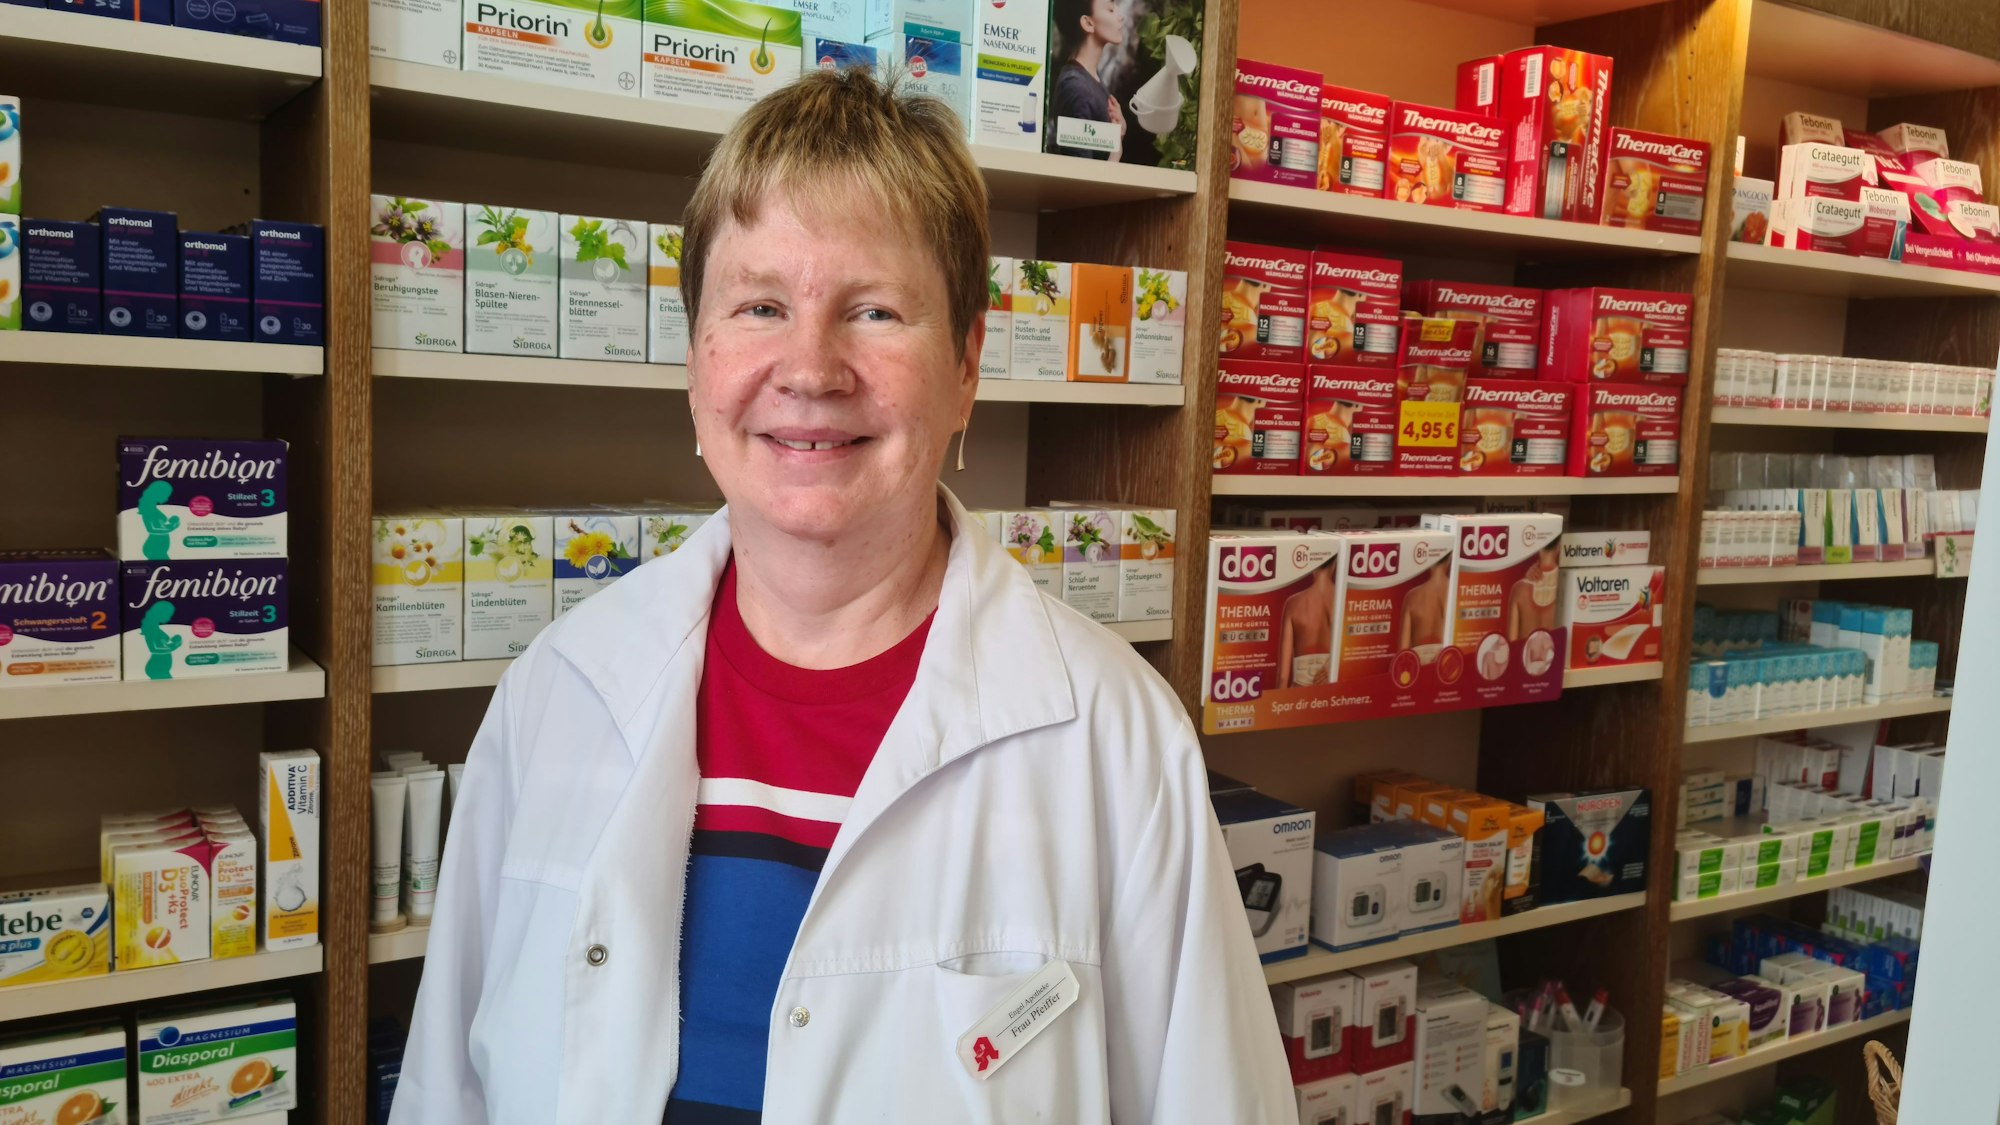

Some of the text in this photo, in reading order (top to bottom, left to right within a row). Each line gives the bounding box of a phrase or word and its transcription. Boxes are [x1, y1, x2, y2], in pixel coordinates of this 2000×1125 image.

[477, 3, 569, 37] Priorin
[478, 26, 519, 40] KAPSELN
[984, 22, 1019, 41] EMSER
[654, 34, 735, 64] Priorin
[984, 38, 1037, 55] NASENDUSCHE
[654, 56, 691, 68] KAPSELN
[1234, 69, 1320, 97] hermaCare
[1321, 98, 1386, 118] ermaCare
[1404, 110, 1503, 140] ThermaCare
[1800, 115, 1833, 131] Tebonin
[1586, 69, 1609, 208] ThermaCare
[1907, 126, 1938, 140] Tebonin
[1273, 140, 1279, 150] 8
[1616, 134, 1703, 160] ThermaCare
[1812, 148, 1860, 166] Crataegutt
[1344, 160, 1349, 169] 8
[1941, 161, 1972, 176] Tebonin
[1457, 177, 1463, 186] 8
[1659, 193, 1664, 202] 8
[1864, 190, 1899, 205] Tebonin
[1816, 202, 1861, 219] Crataegutt
[1960, 204, 1990, 218] Tebonin
[108, 217, 153, 228] orthomol
[28, 228, 74, 239] orthomol
[260, 230, 301, 240] orthomol
[184, 241, 227, 252] orthomol
[1316, 262, 1399, 283] ThermaCare
[374, 283, 439, 296] Beruhigungstee
[475, 289, 540, 301] Blasen-Nieren-
[475, 300, 508, 310] Spültee
[570, 298, 624, 309] Brennnessel-
[1438, 288, 1536, 309] ThermaCare
[1599, 295, 1688, 314] ThermaCare
[78, 309, 88, 317] 10
[570, 308, 598, 317] blätter
[1260, 304, 1279, 312] NACKEN
[228, 318, 238, 326] 10
[1260, 319, 1268, 328] 12
[1015, 333, 1052, 342] Bronchialtee
[1136, 333, 1173, 342] Johanniskraut
[1356, 327, 1364, 336] 12
[1547, 306, 1558, 366] ThermaCare
[1408, 346, 1472, 358] ThermaCare
[1487, 348, 1494, 356] 16
[1313, 375, 1394, 392] ThermaCare
[1467, 386, 1565, 404] ThermaCare
[1595, 390, 1677, 406] ThermaCare
[1403, 421, 1455, 441] 4,95 €
[1254, 434, 1264, 443] 12
[1353, 437, 1361, 446] 12
[1516, 445, 1524, 453] 16
[1400, 453, 1454, 463] ThermaCare
[126, 445, 276, 488] femibion
[228, 493, 257, 501] Stillzeit
[260, 489, 275, 508] 3
[1463, 526, 1508, 556] doc
[1296, 550, 1309, 563] 8h
[1564, 544, 1603, 558] Voltaren
[1222, 546, 1274, 579] doc
[1352, 543, 1398, 574] doc
[1126, 572, 1162, 581] Spitzwegerich
[0, 572, 107, 608] mibion
[129, 566, 278, 609] femibion
[1460, 584, 1502, 596] THERMA
[1577, 577, 1629, 593] Voltaren
[376, 602, 445, 612] Kamillenblüten
[472, 598, 527, 608] Lindenblüten
[1348, 599, 1393, 612] THERMA
[229, 610, 259, 618] Stillzeit
[262, 606, 277, 623] 3
[1220, 605, 1271, 618] THERMA
[1461, 608, 1499, 618] NACKEN
[14, 616, 88, 627] Schwangerschaft
[91, 611, 107, 630] 2
[1348, 624, 1389, 634] RÜCKEN
[1221, 632, 1267, 641] RÜCKEN
[1214, 671, 1260, 700] doc
[1216, 705, 1255, 716] THERMA
[1272, 695, 1373, 714] Spar dir den Schmerz.
[288, 766, 296, 811] ADDITIVA
[297, 765, 308, 814] Vitamin C
[1273, 819, 1312, 834] OMRON
[1380, 853, 1402, 864] OMRON
[218, 864, 255, 874] Protect
[158, 869, 178, 915] D3 +K2
[180, 867, 189, 929] DuoProtect
[8, 940, 32, 952] plus
[1008, 982, 1050, 1019] Engel Apotheke
[1011, 992, 1061, 1038] Frau Pfeiffer
[184, 1027, 250, 1043] MAGNESIUM
[152, 1043, 235, 1069] Diasporal
[7, 1058, 77, 1075] MAGNESIUM
[0, 1074, 60, 1099] sporal
[146, 1073, 201, 1086] 400 EXTRA
